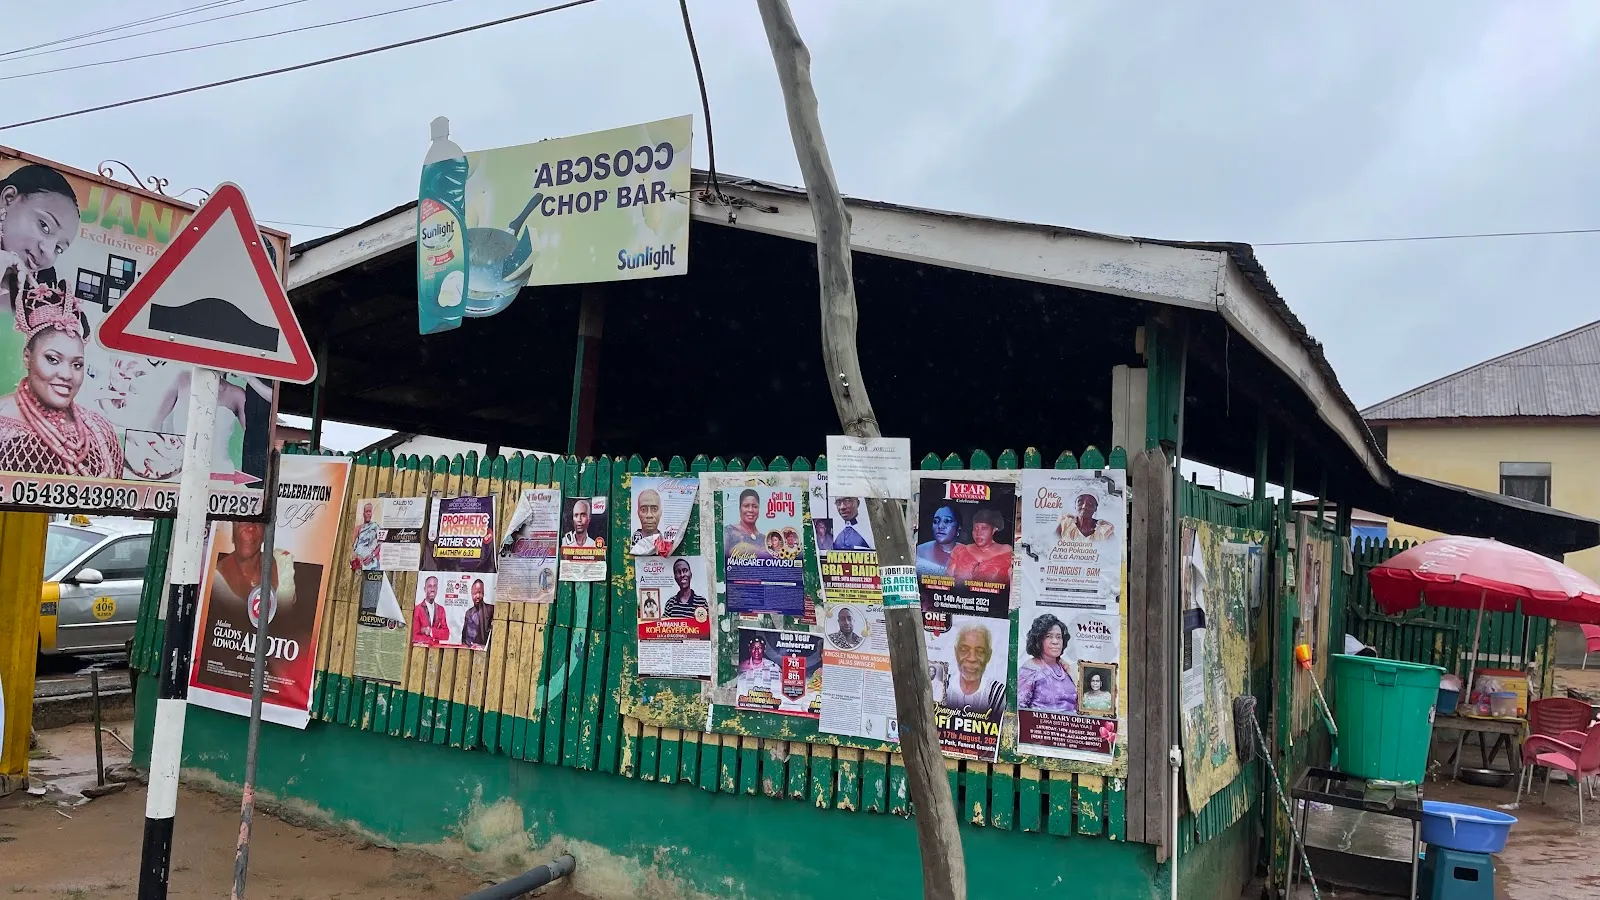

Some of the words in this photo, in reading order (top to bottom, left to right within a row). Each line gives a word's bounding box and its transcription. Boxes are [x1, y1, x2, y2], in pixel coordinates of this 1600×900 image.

[541, 189, 608, 217] CHOP
[616, 180, 666, 208] BAR
[80, 186, 192, 244] JAN
[422, 221, 454, 240] Sunlight
[80, 227, 142, 254] Exclusive
[617, 244, 676, 270] Sunlight
[277, 483, 331, 502] CELEBRATION
[952, 483, 986, 495] YEAR
[1038, 487, 1059, 499] One
[12, 481, 138, 508] 0543843930
[155, 489, 260, 514] 0507287
[772, 492, 783, 500] Call
[785, 492, 792, 500] to
[766, 499, 795, 518] glory
[1034, 497, 1063, 509] Week
[442, 514, 488, 525] PROPHETIC
[438, 538, 463, 547] FATHER
[465, 538, 483, 547] SON
[727, 558, 764, 567] MARGARET
[765, 559, 793, 568] OWUSU
[822, 564, 843, 576] BRA
[1059, 566, 1082, 576] AUGUST
[367, 573, 383, 581] GLOR
[934, 593, 942, 601] On
[943, 594, 955, 602] 14th
[956, 595, 975, 605] August
[976, 597, 990, 606] 2021
[96, 602, 114, 612] 406
[925, 612, 947, 622] ONE
[213, 626, 242, 640] GLADYS
[1077, 623, 1112, 635] Week
[780, 632, 794, 641] One
[794, 633, 811, 642] Year
[1076, 632, 1112, 641] Observation
[212, 637, 240, 651] ADWOA
[240, 632, 299, 661] AOTO
[776, 641, 815, 650] Anniversary
[962, 704, 993, 720] Samuel
[935, 714, 951, 730] FI
[954, 717, 999, 736] PENYA
[1051, 713, 1071, 722] MARY
[1071, 716, 1101, 726] ODURAA
[943, 731, 957, 739] 17th
[984, 736, 997, 745] 202
